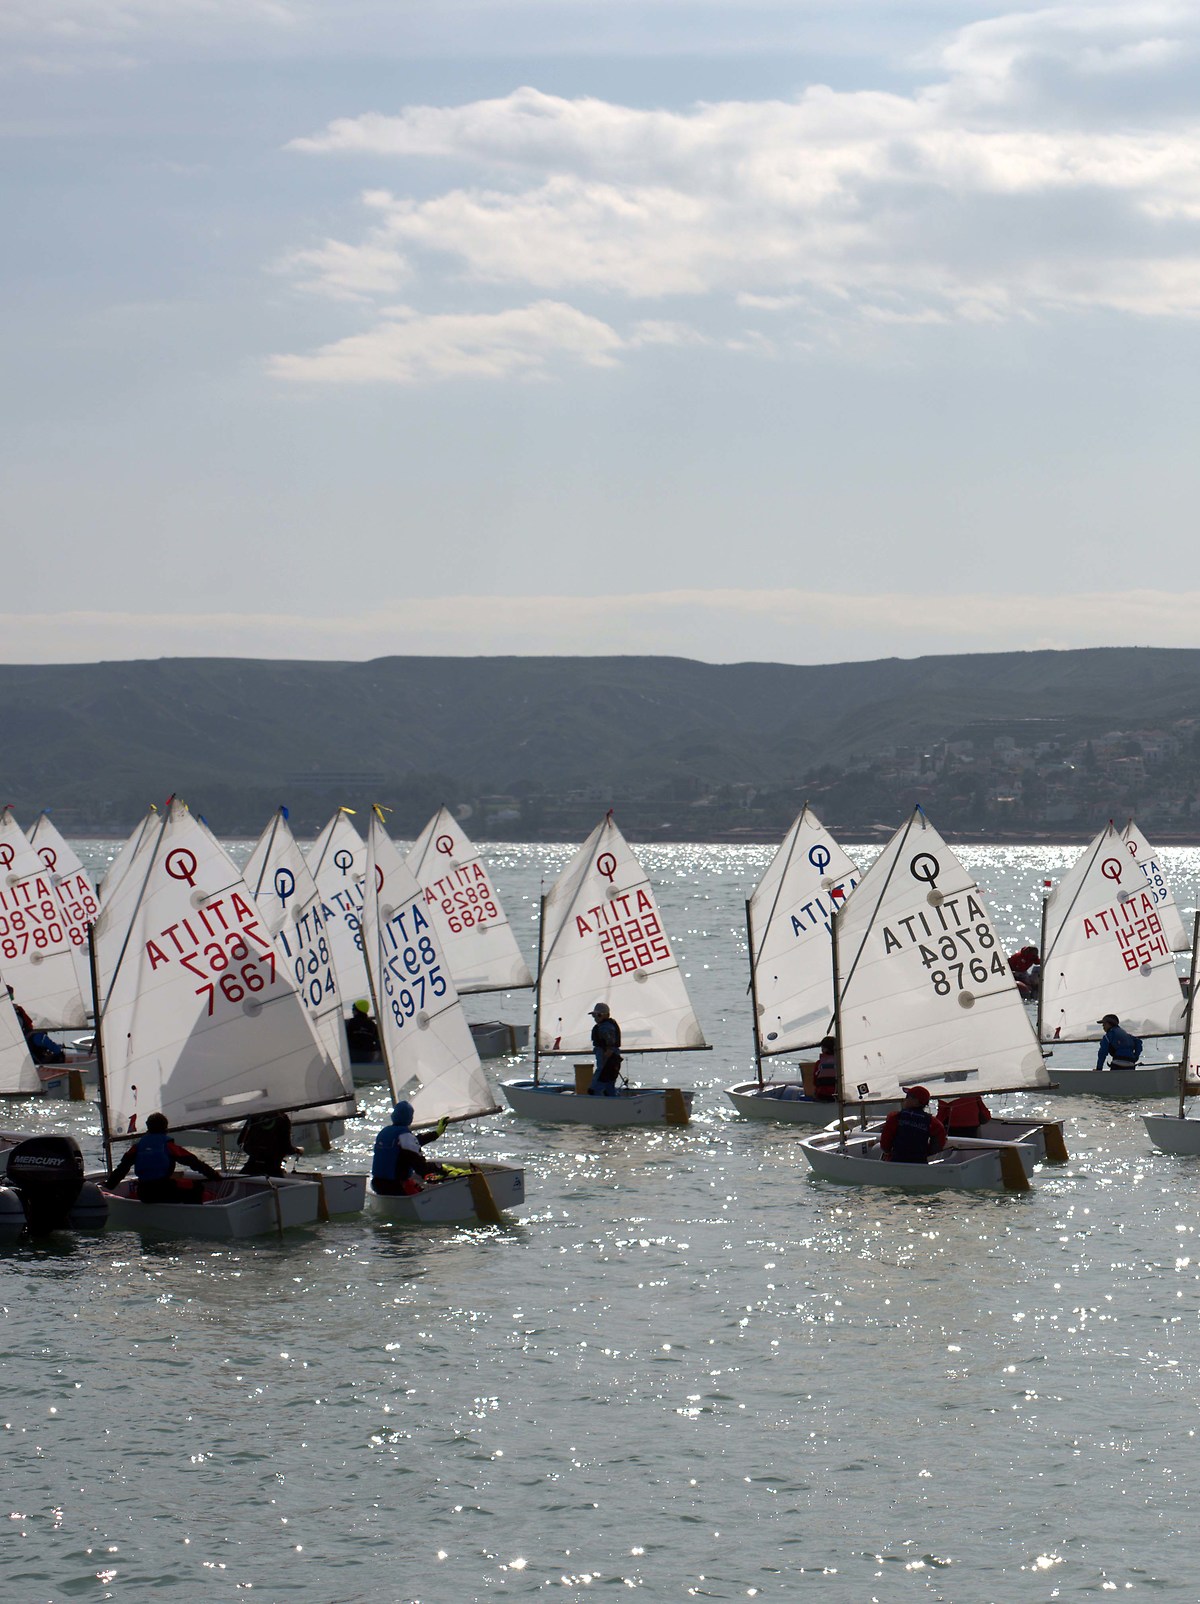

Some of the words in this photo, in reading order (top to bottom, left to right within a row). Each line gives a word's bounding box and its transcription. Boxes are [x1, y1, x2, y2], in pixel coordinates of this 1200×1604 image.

[1139, 861, 1160, 876] TA
[11, 878, 50, 906] ITA
[55, 875, 90, 904] ITA
[386, 904, 429, 949] ITA
[448, 904, 498, 933] 6829
[2, 923, 62, 958] 8780
[606, 936, 670, 977] 6685
[1122, 935, 1168, 972] 8541
[196, 952, 275, 1016] 7667
[930, 951, 1006, 996] 8764
[392, 965, 446, 1028] 8975
[14, 1156, 64, 1166] MERCURY
